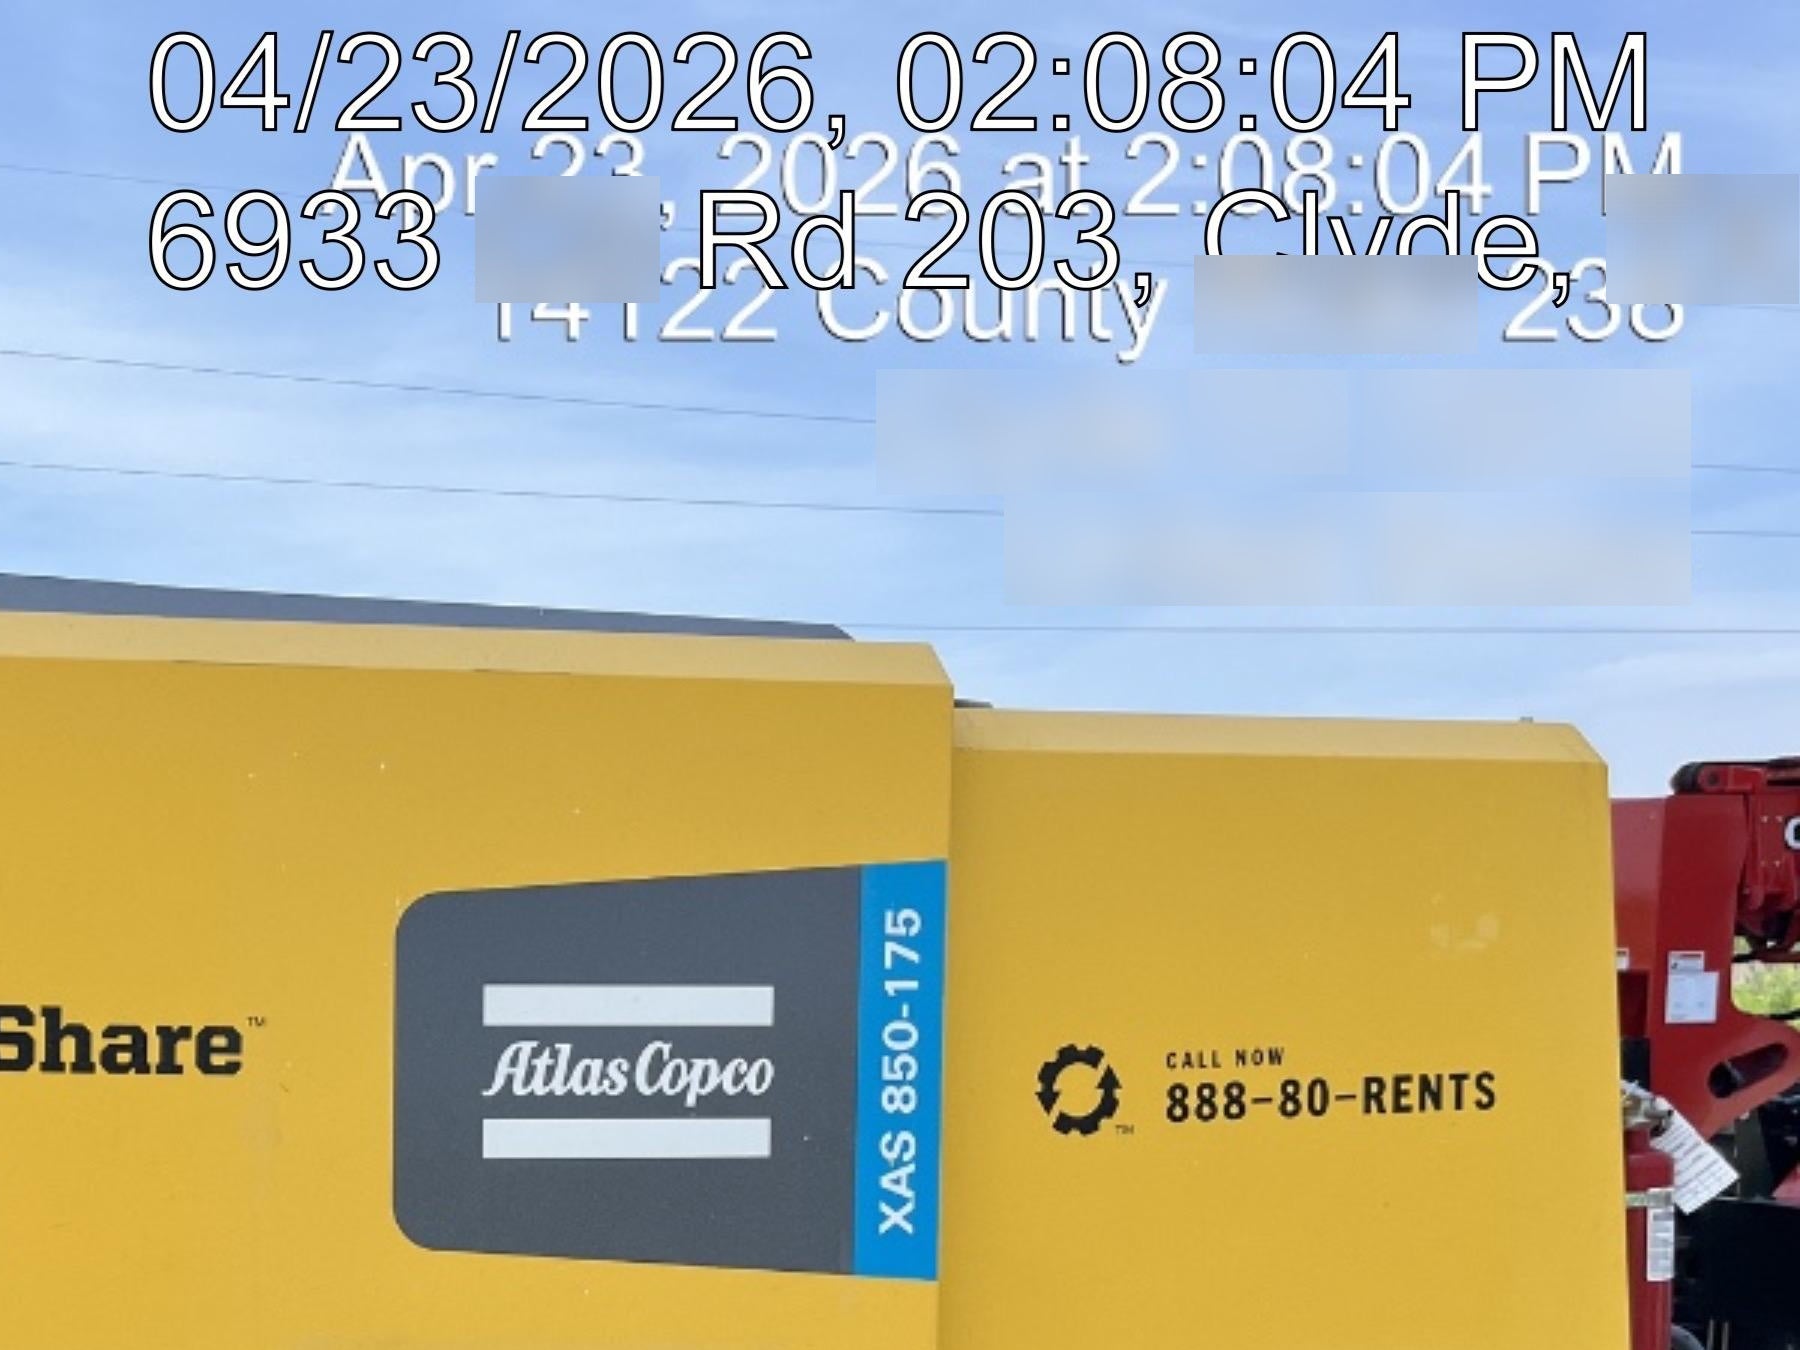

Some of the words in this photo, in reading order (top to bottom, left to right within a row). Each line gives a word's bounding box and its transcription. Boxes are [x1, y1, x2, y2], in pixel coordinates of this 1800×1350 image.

[881, 908, 923, 1114] 850-175
[482, 1040, 630, 1098] Atlas
[635, 1040, 774, 1107] Copco
[1166, 1051, 1222, 1069] CALL
[1235, 1047, 1285, 1067] NOW
[1166, 1071, 1497, 1123] 888-80-RENTS
[879, 1130, 916, 1235] XAS
